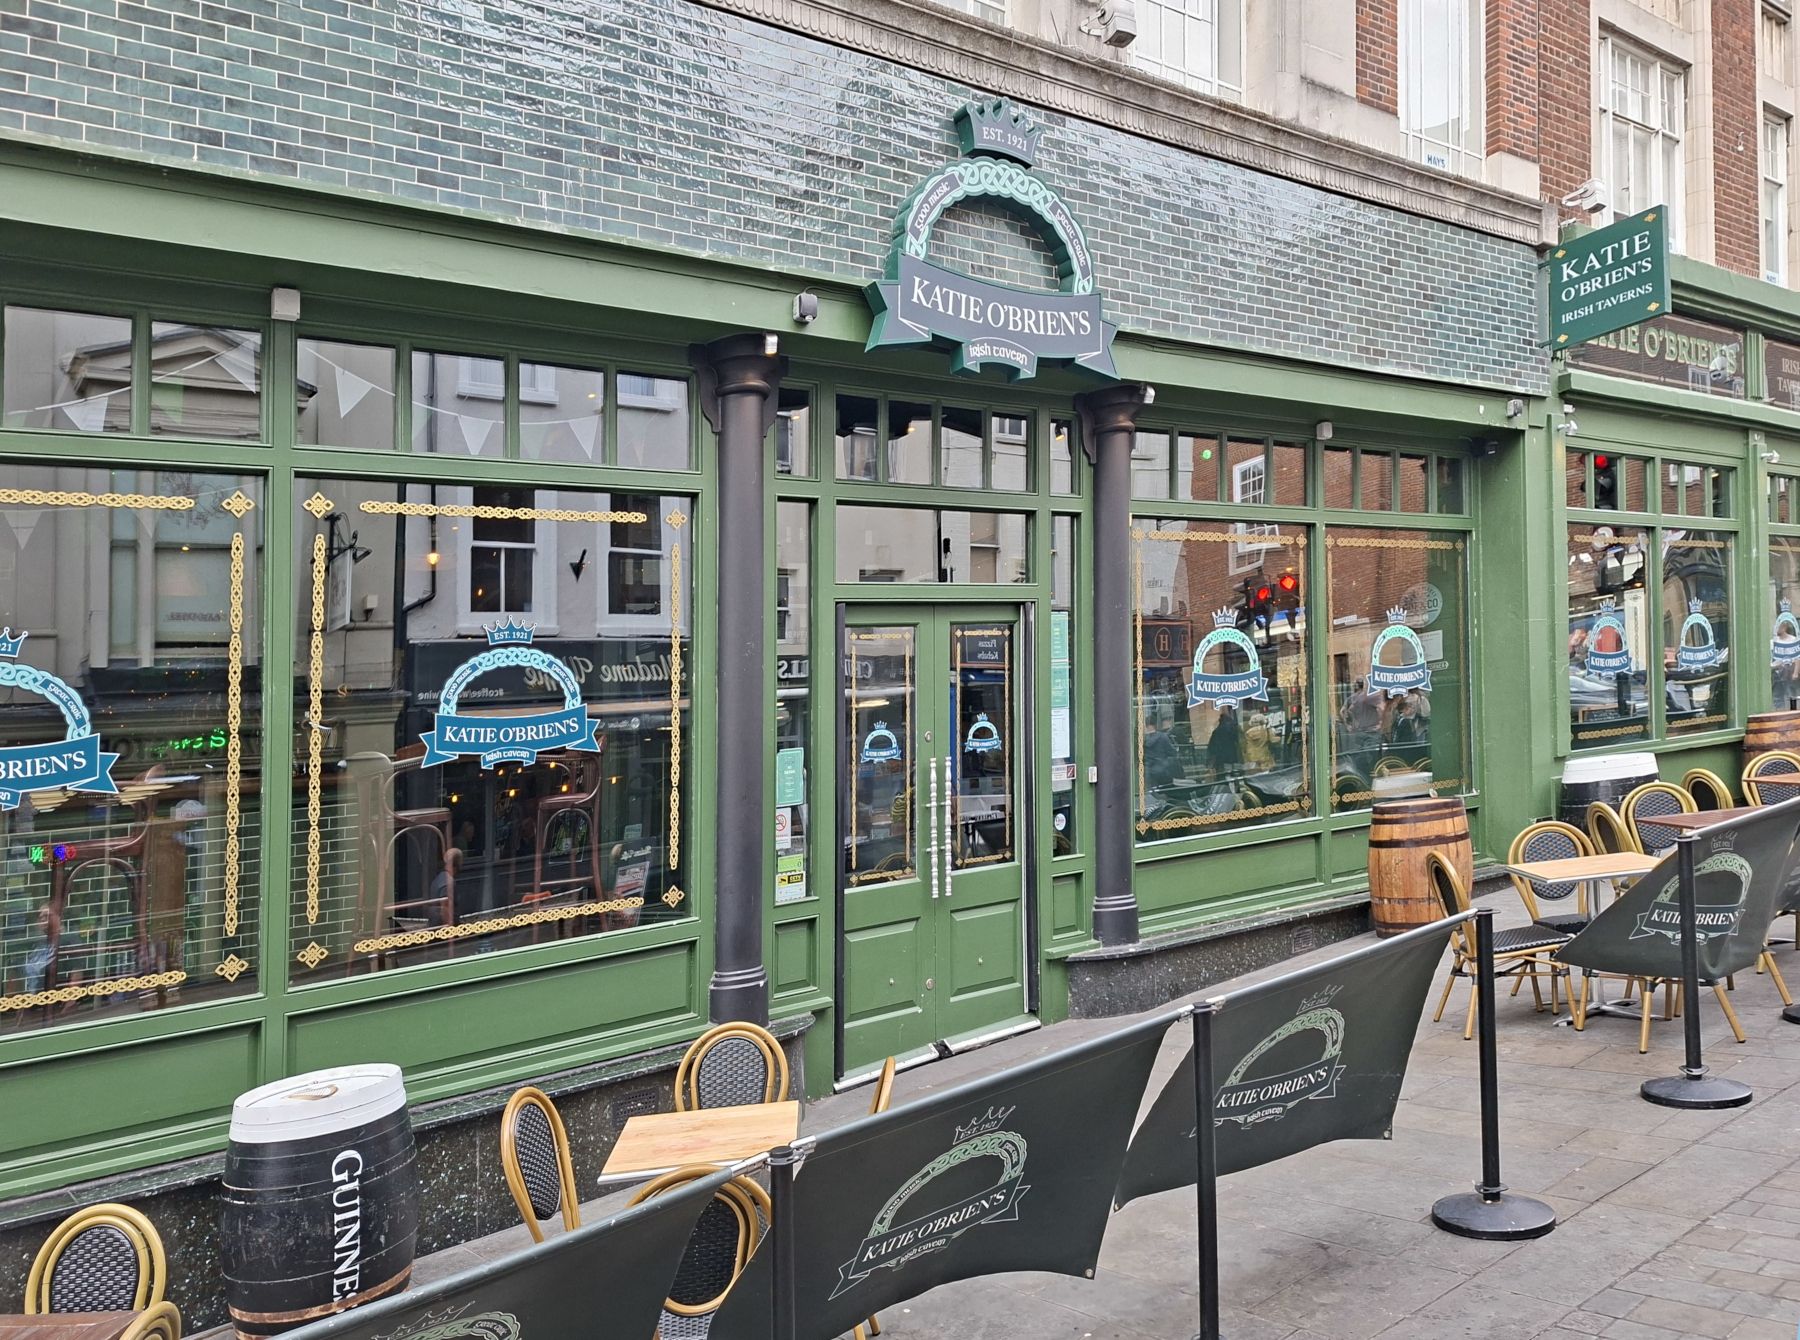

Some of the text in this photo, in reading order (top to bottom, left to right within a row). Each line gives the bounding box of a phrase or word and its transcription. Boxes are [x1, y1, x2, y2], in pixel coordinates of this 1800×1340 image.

[982, 126, 1027, 152] EST. 1921
[1561, 230, 1651, 282] KATIE
[1561, 257, 1653, 302] O'BRIEN'S
[911, 276, 1092, 337] KATIE O'BRIEN'S
[1561, 283, 1653, 324] IRISH TAVERNS
[0, 643, 12, 652] 21
[494, 631, 528, 640] EST. 1921
[1197, 679, 1221, 693] KATIE
[444, 725, 497, 743] KATIE
[499, 717, 579, 743] O'BRIEN'S
[1651, 909, 1682, 924] KATI
[1216, 1066, 1328, 1108] KATIE O'BRIEN'S
[862, 1189, 1007, 1263] KATIE O'BRIEN'S
